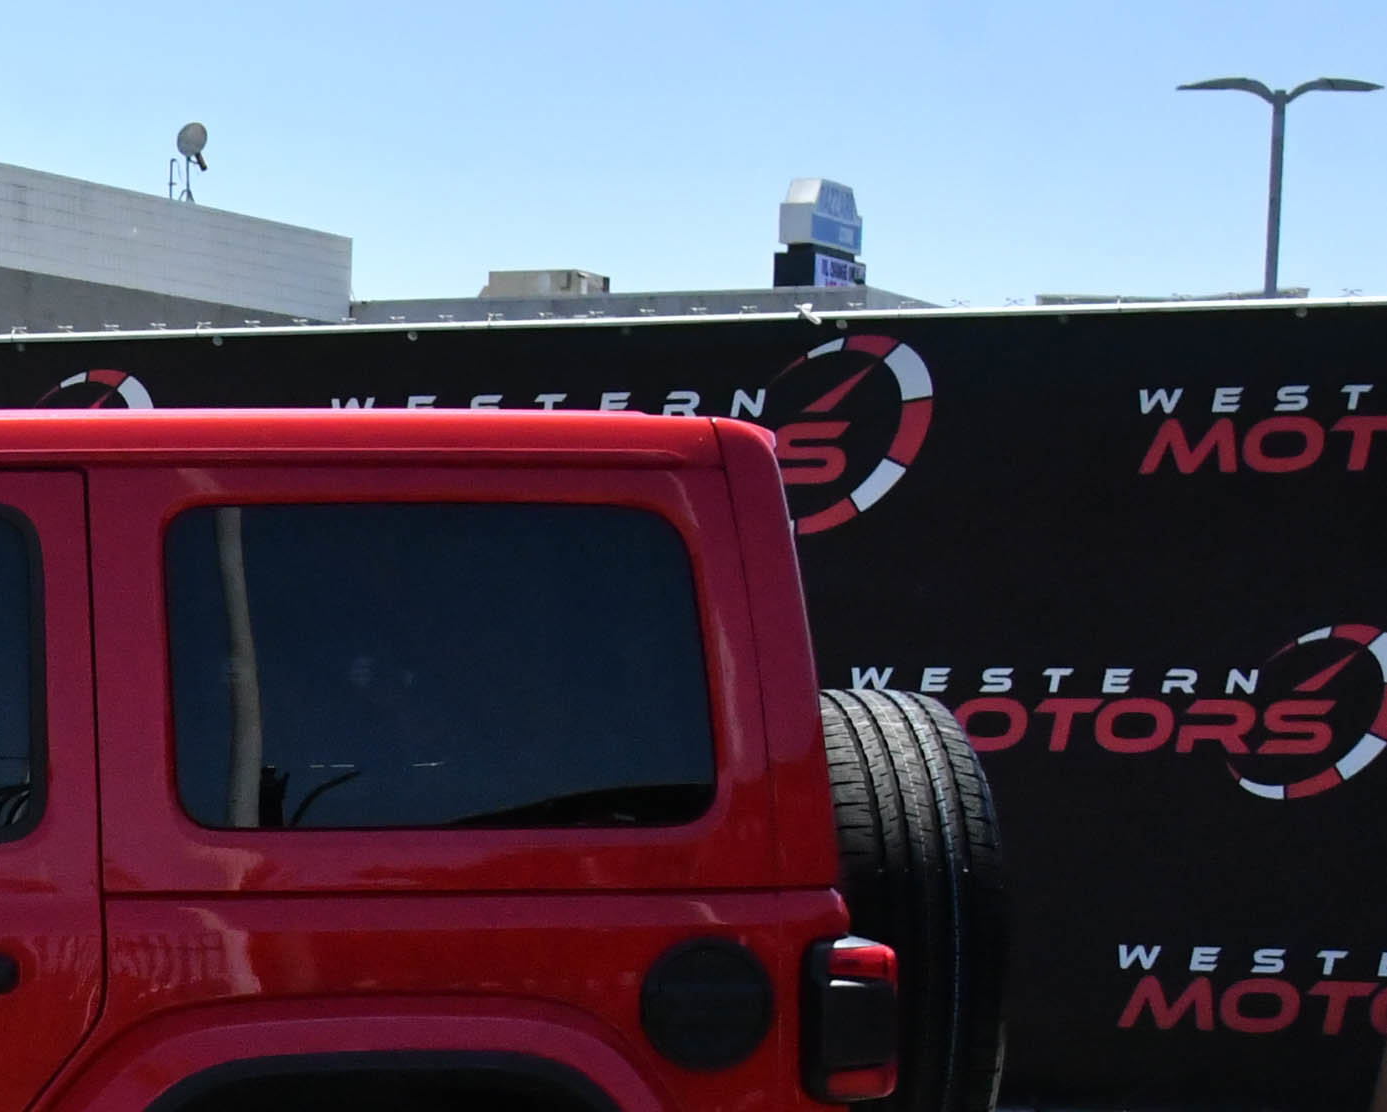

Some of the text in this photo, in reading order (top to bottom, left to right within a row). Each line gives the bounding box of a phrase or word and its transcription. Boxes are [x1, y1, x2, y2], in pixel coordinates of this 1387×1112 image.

[850, 667, 1259, 695] WESTERN
[948, 698, 1337, 755] OTORS
[1119, 944, 1387, 976] WEST
